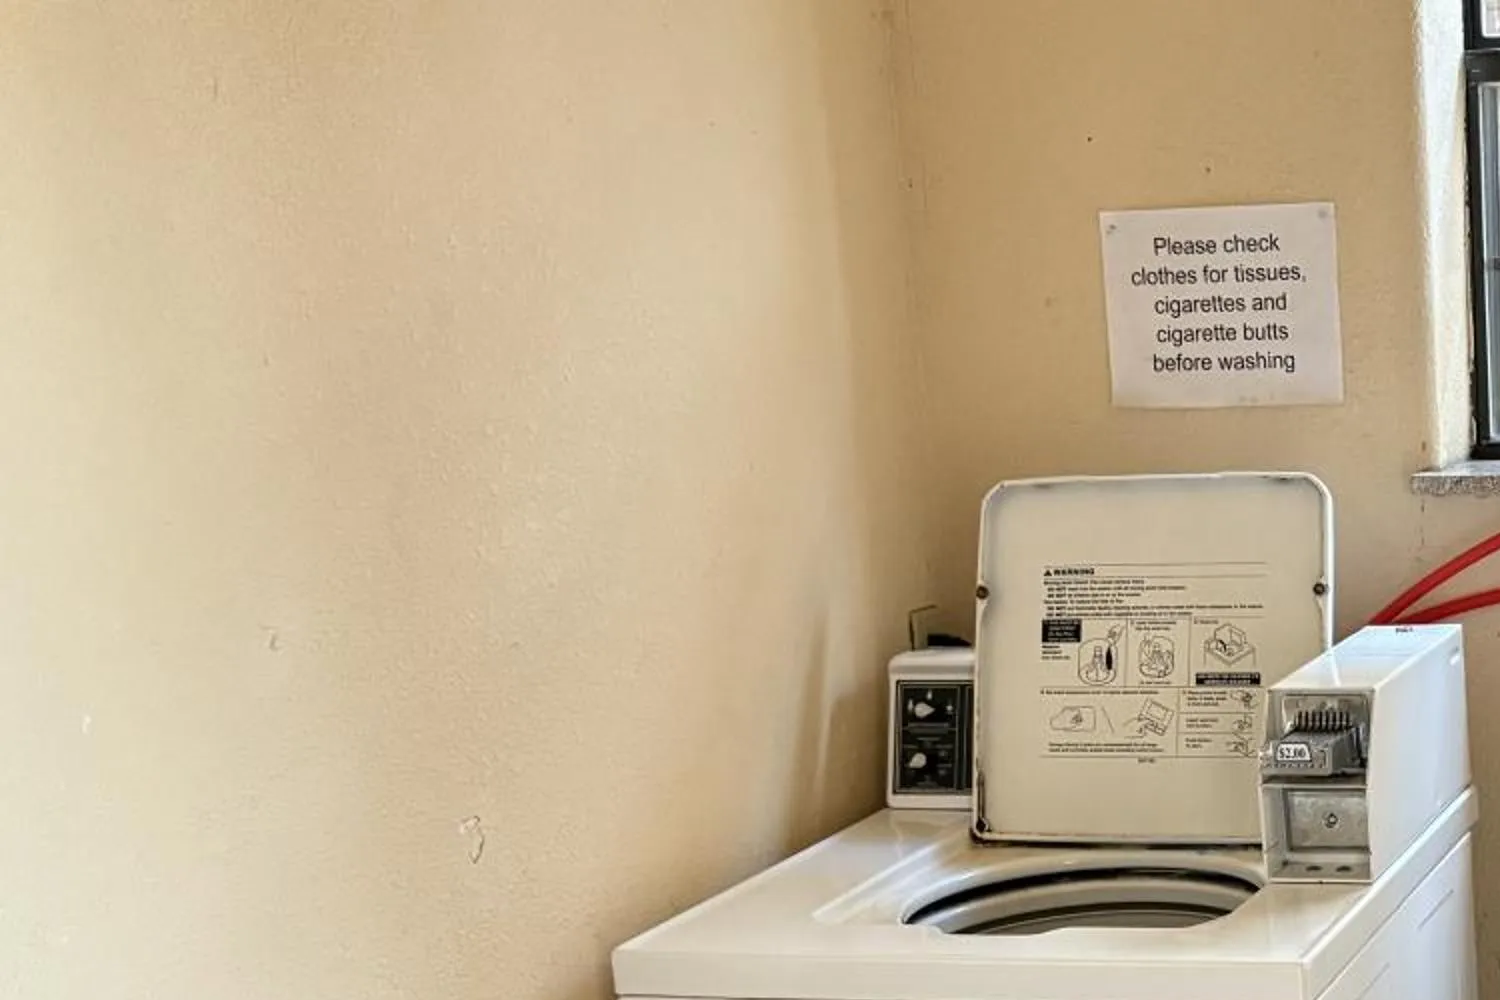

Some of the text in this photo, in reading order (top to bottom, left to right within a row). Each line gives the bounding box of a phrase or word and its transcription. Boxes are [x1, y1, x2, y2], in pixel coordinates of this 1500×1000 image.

[1153, 233, 1281, 256] Please check
[1131, 264, 1307, 286] clothes for tissues,
[1154, 293, 1288, 319] cigarettes and
[1156, 323, 1290, 347] cigarette butts
[1153, 351, 1296, 373] before washing
